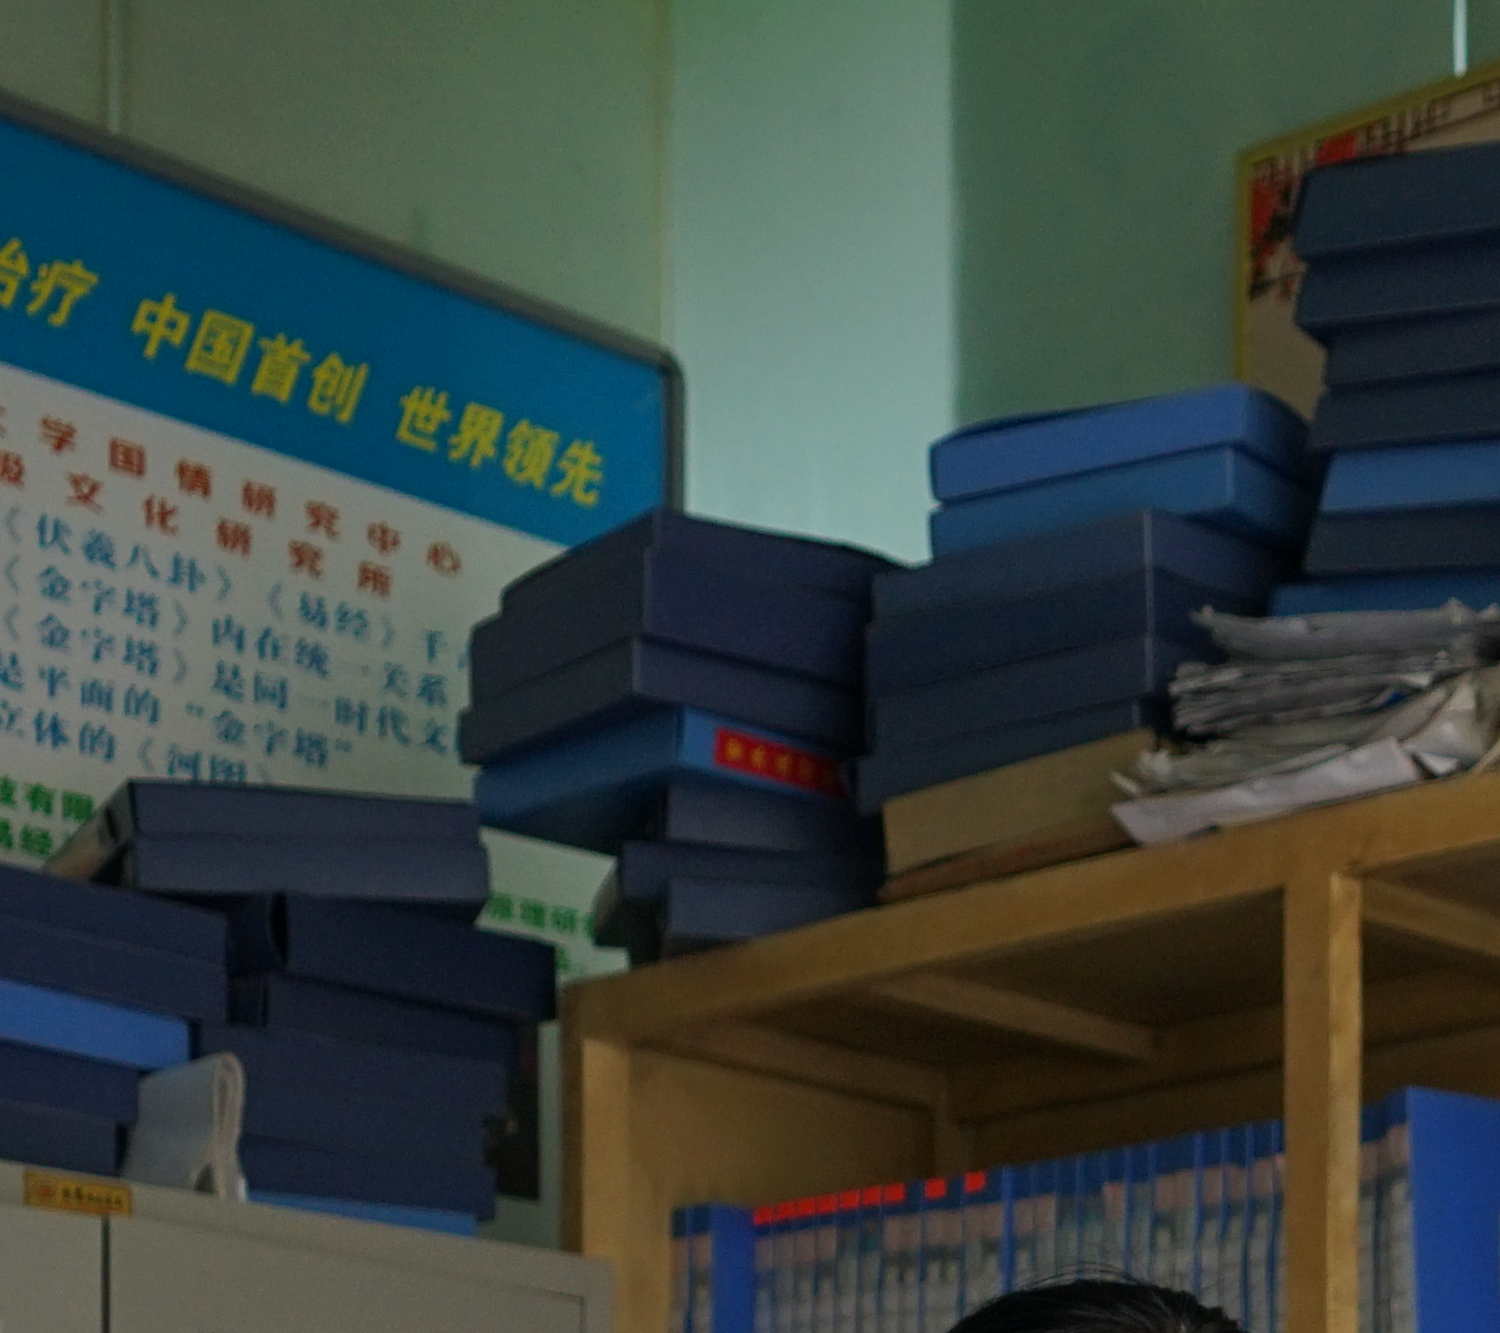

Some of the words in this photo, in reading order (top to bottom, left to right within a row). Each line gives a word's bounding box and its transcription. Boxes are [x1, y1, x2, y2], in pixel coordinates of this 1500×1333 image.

[132, 292, 370, 426] 中国首创
[396, 386, 606, 508] 世界领先
